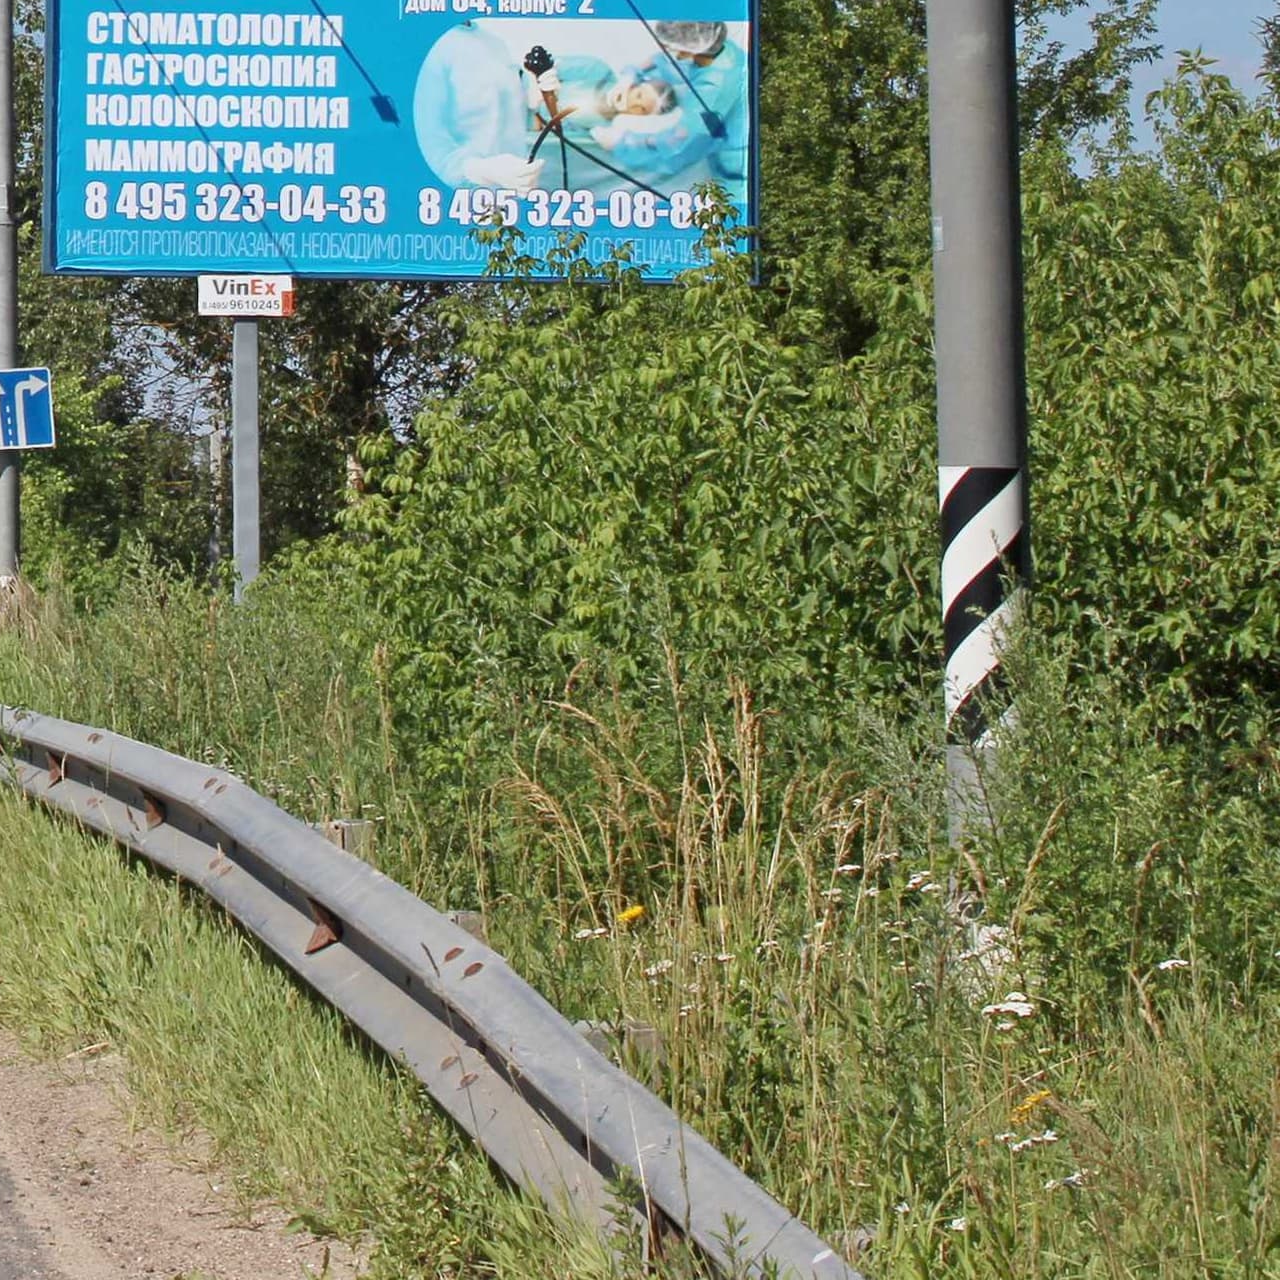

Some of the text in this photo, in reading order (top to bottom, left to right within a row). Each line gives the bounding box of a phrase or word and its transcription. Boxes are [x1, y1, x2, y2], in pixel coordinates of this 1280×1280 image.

[87, 11, 343, 47] СТОМАТОЛОГИЯ
[87, 52, 336, 87] ГАСТРОСКОПИЯ
[86, 94, 349, 129] КОЛОНОСКОПИЯ
[85, 138, 334, 175] МАММОГРАФИЯ
[85, 181, 386, 224] 8 495 323-04-33
[418, 187, 440, 225] 8
[449, 188, 518, 227] 495
[66, 229, 138, 256] ИМЕЮТСЯ
[142, 230, 297, 258] ПРОТИВОПОКАЗАНИЯ.
[302, 232, 401, 262] НЕОБХОДИМО
[212, 279, 276, 295] VinEx
[230, 300, 280, 310] 9610245
